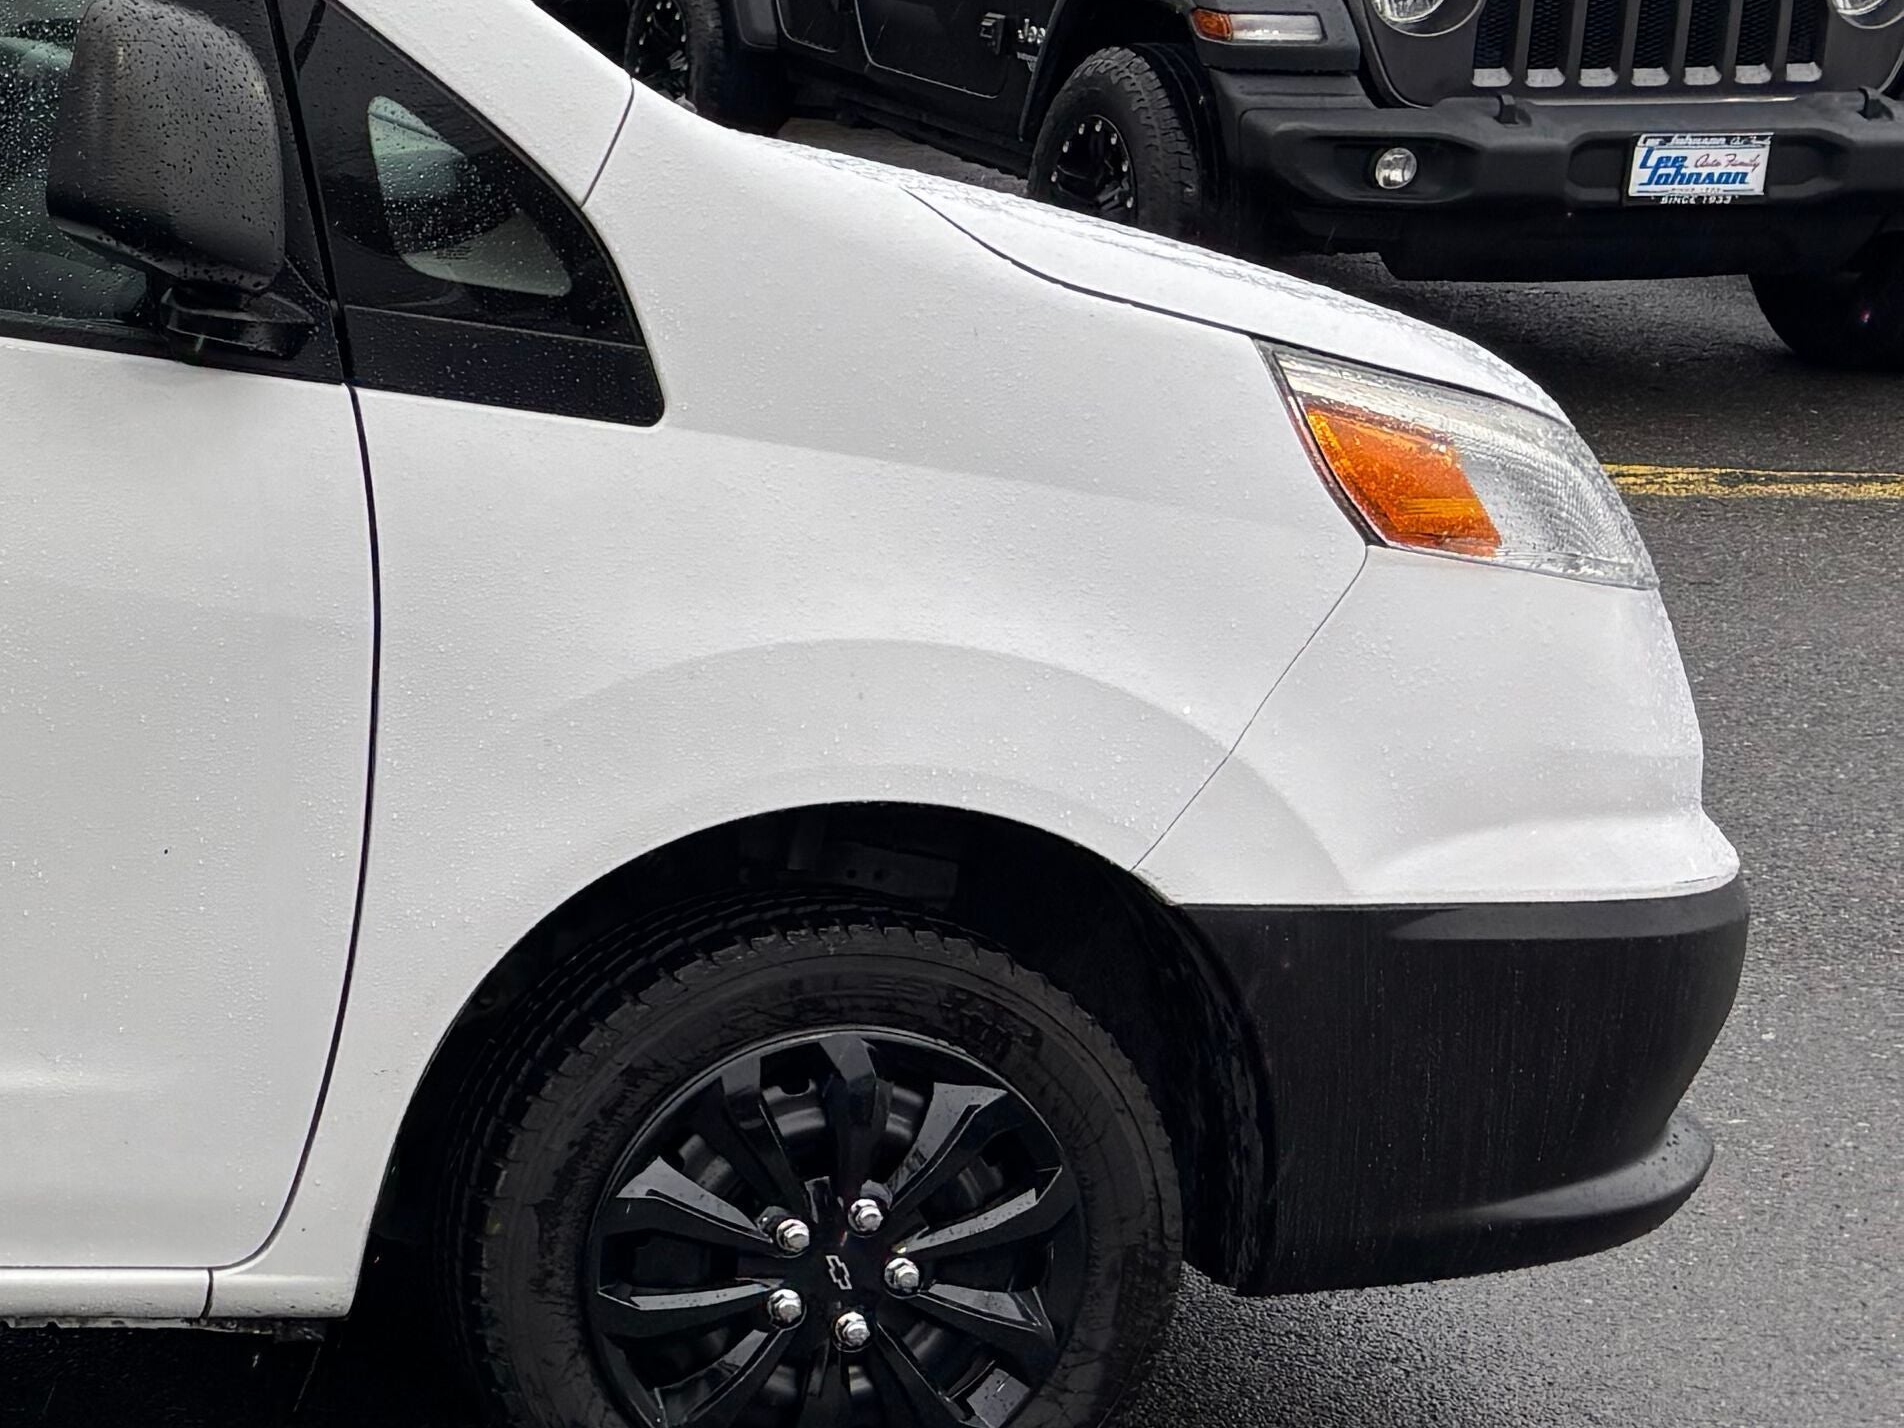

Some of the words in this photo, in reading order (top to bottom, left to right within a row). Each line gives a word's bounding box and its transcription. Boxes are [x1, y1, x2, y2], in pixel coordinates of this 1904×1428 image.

[1639, 147, 1688, 169] Lee
[1638, 164, 1750, 185] Johnson
[1660, 195, 1697, 204] SINCE
[1702, 194, 1732, 204] 1933
